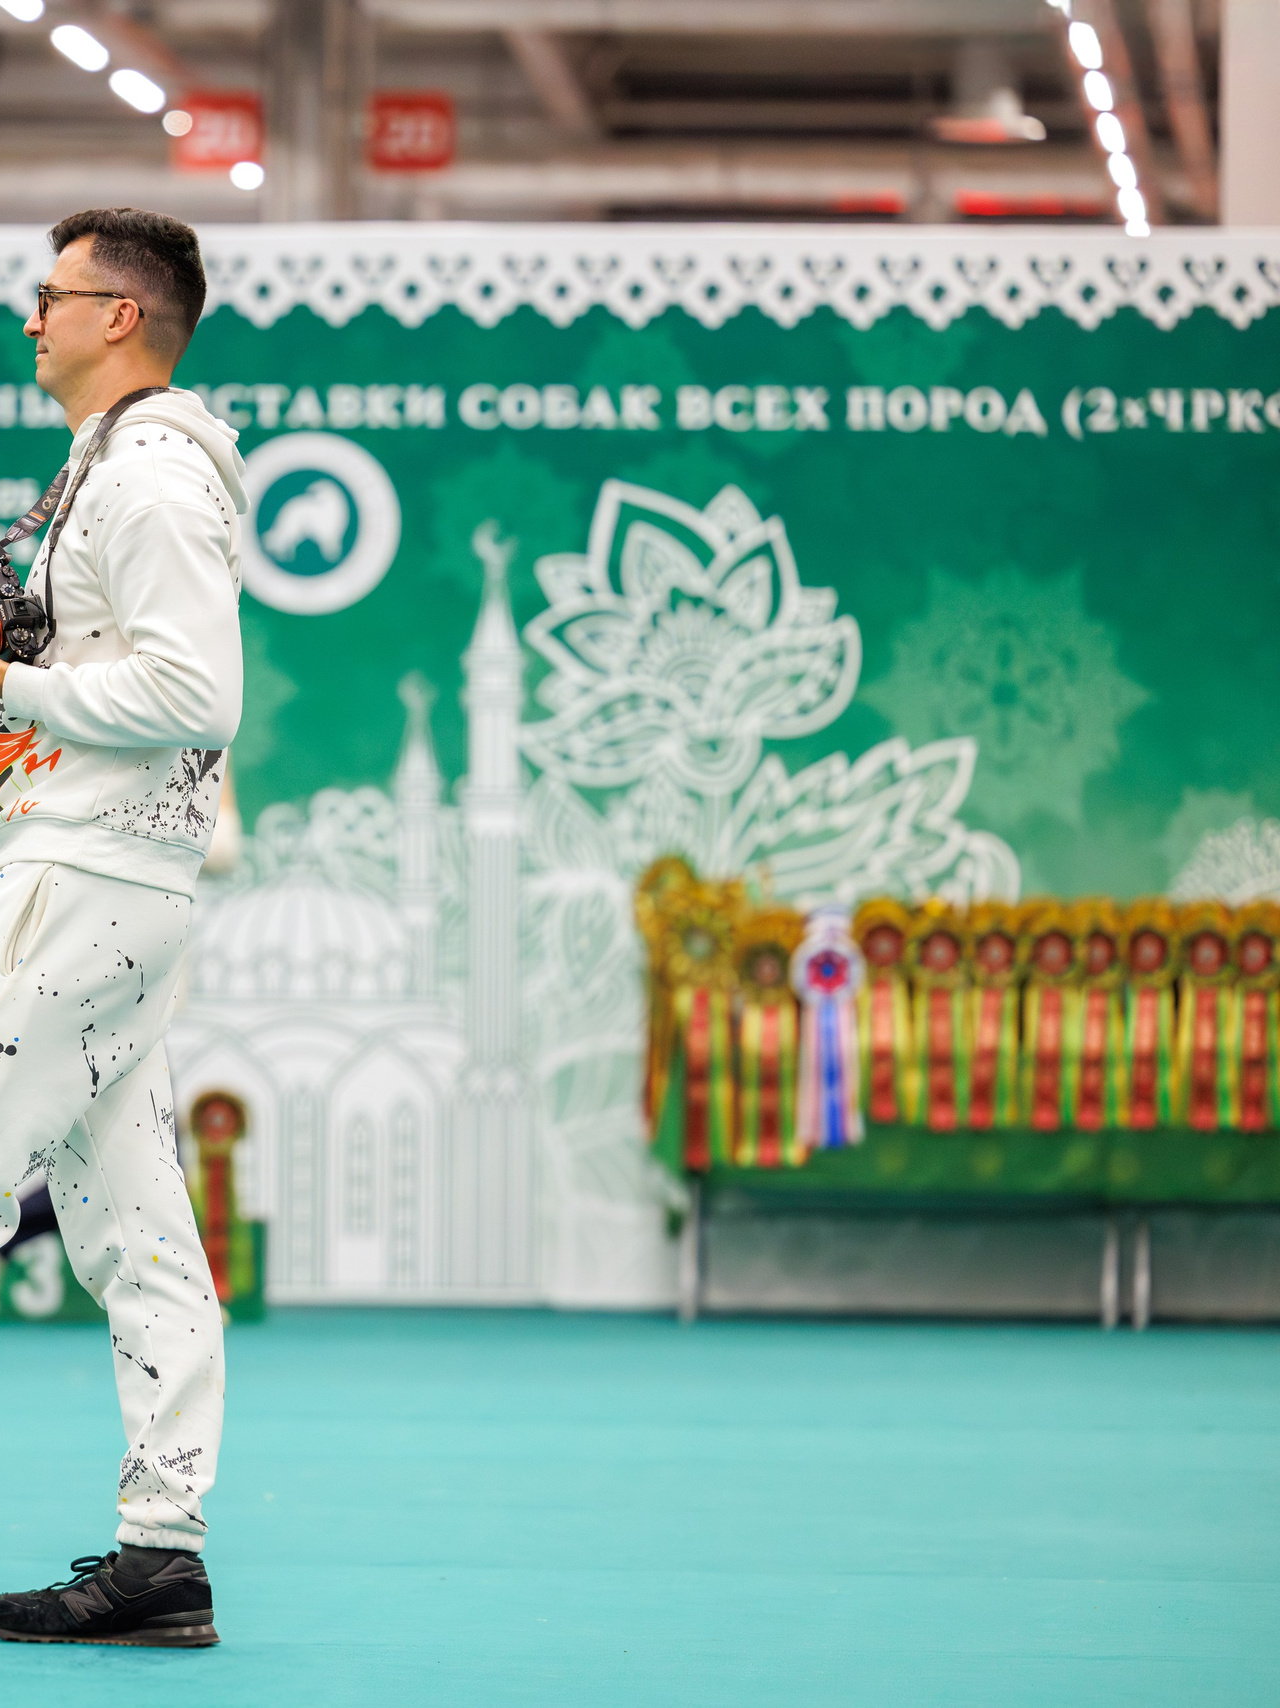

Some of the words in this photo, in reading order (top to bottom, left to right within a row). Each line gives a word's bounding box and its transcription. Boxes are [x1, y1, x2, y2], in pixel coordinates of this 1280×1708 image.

[458, 384, 661, 431] СОБАК
[676, 385, 830, 432] ВСЕХ
[846, 385, 1049, 437] ПОРОД
[10, 1232, 66, 1318] 3
